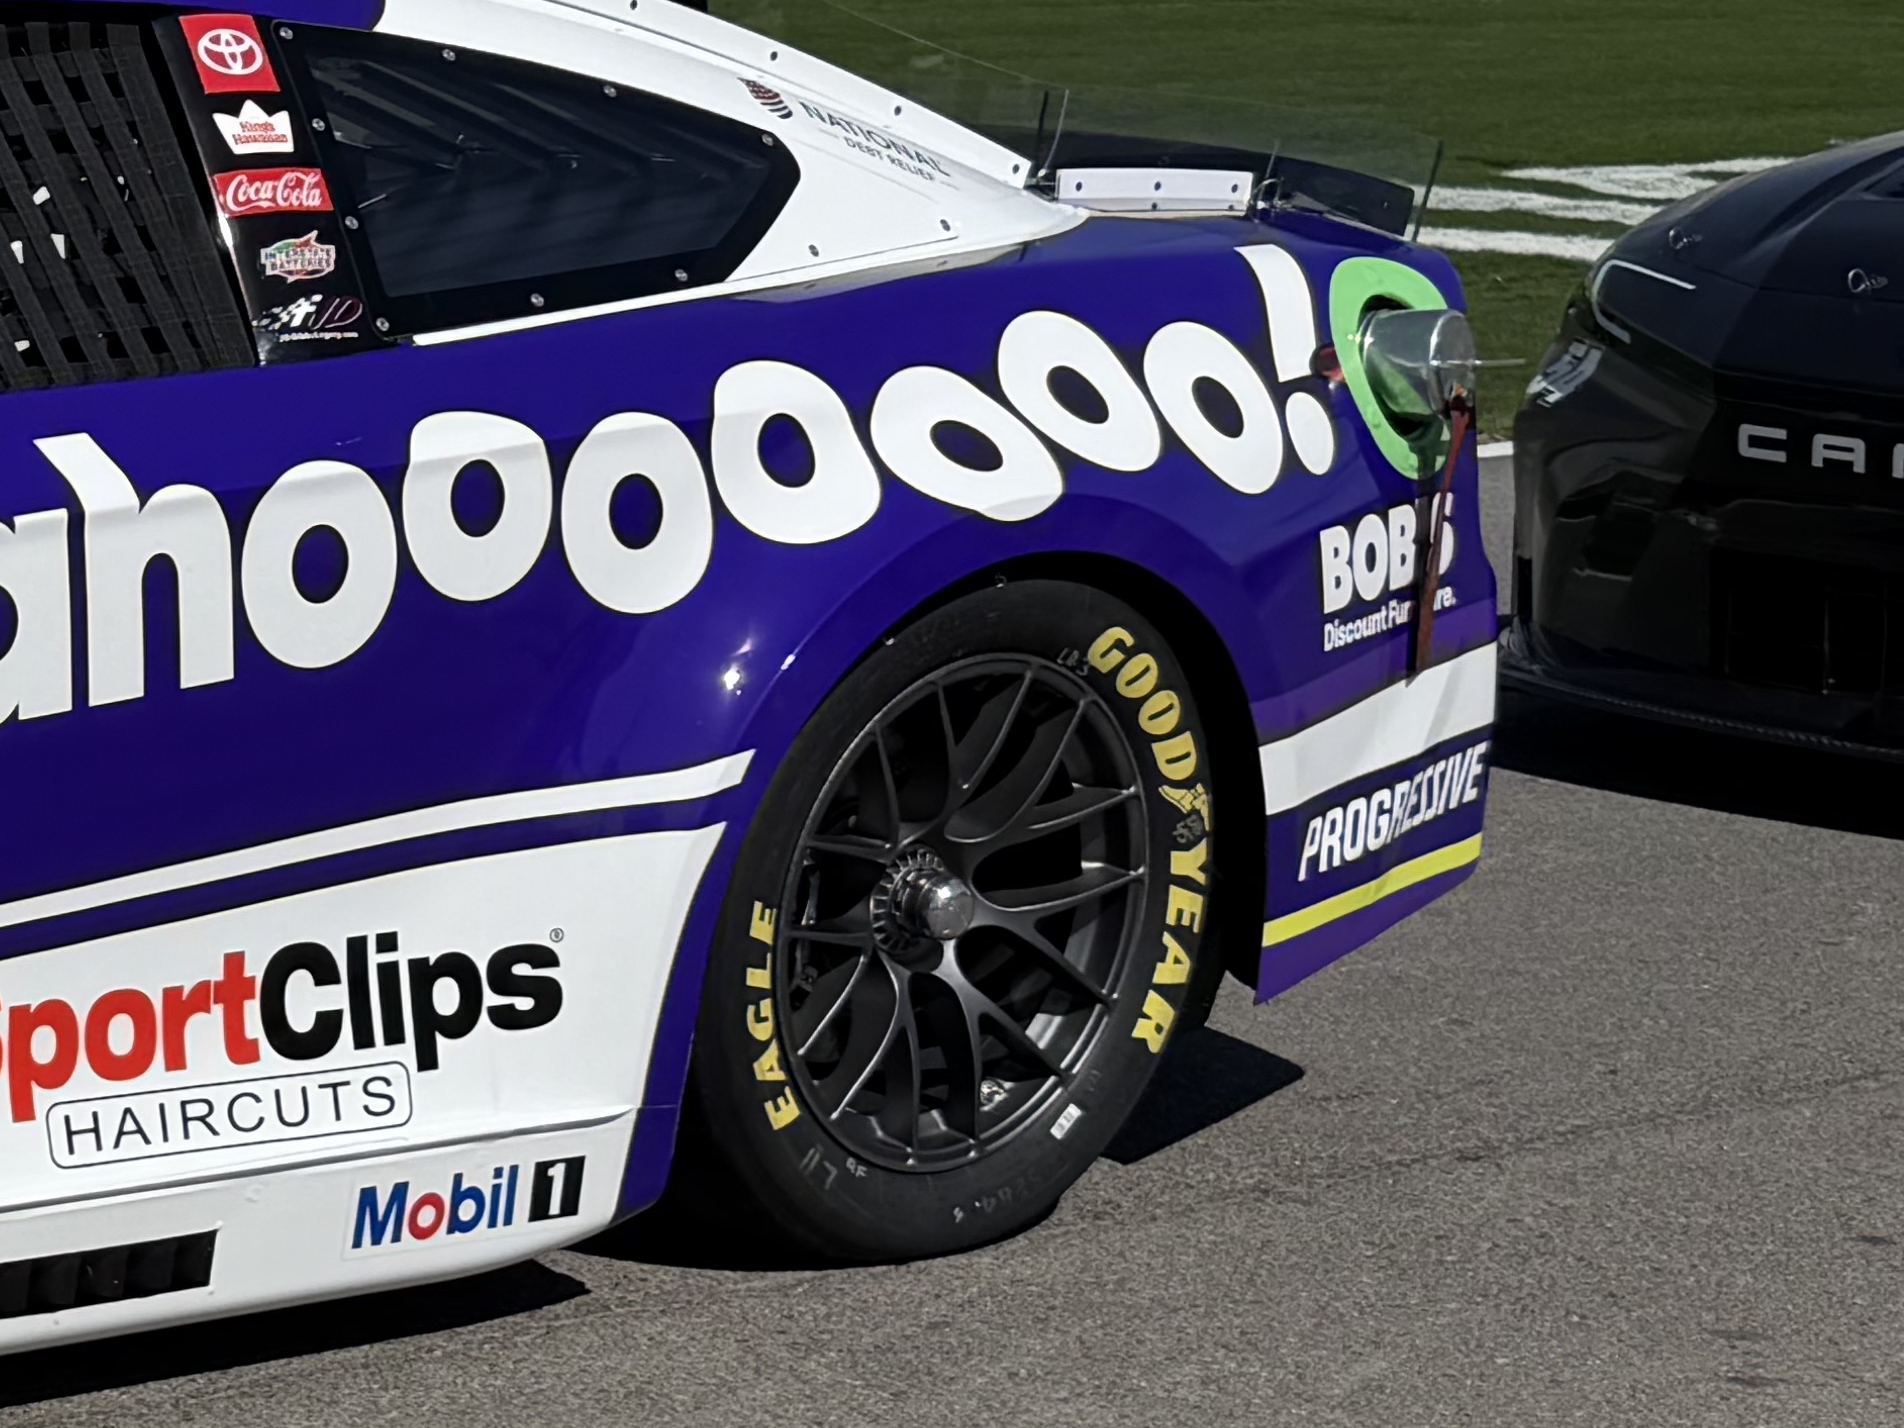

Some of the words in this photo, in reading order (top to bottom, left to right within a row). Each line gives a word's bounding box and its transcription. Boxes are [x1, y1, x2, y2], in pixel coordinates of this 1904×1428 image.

[799, 101, 951, 177] NATIONAL
[225, 171, 323, 212] Coca-Cola
[1737, 422, 1904, 479] CA
[1319, 491, 1455, 615] BOBS
[1323, 605, 1388, 652] Discount
[1086, 626, 1214, 1055] GOODYEAR
[1298, 740, 1489, 883] PROGRESSIVE
[746, 900, 802, 1131] EAGLE
[63, 1075, 398, 1158] HAIRCUTS
[352, 1163, 519, 1250] Mobil
